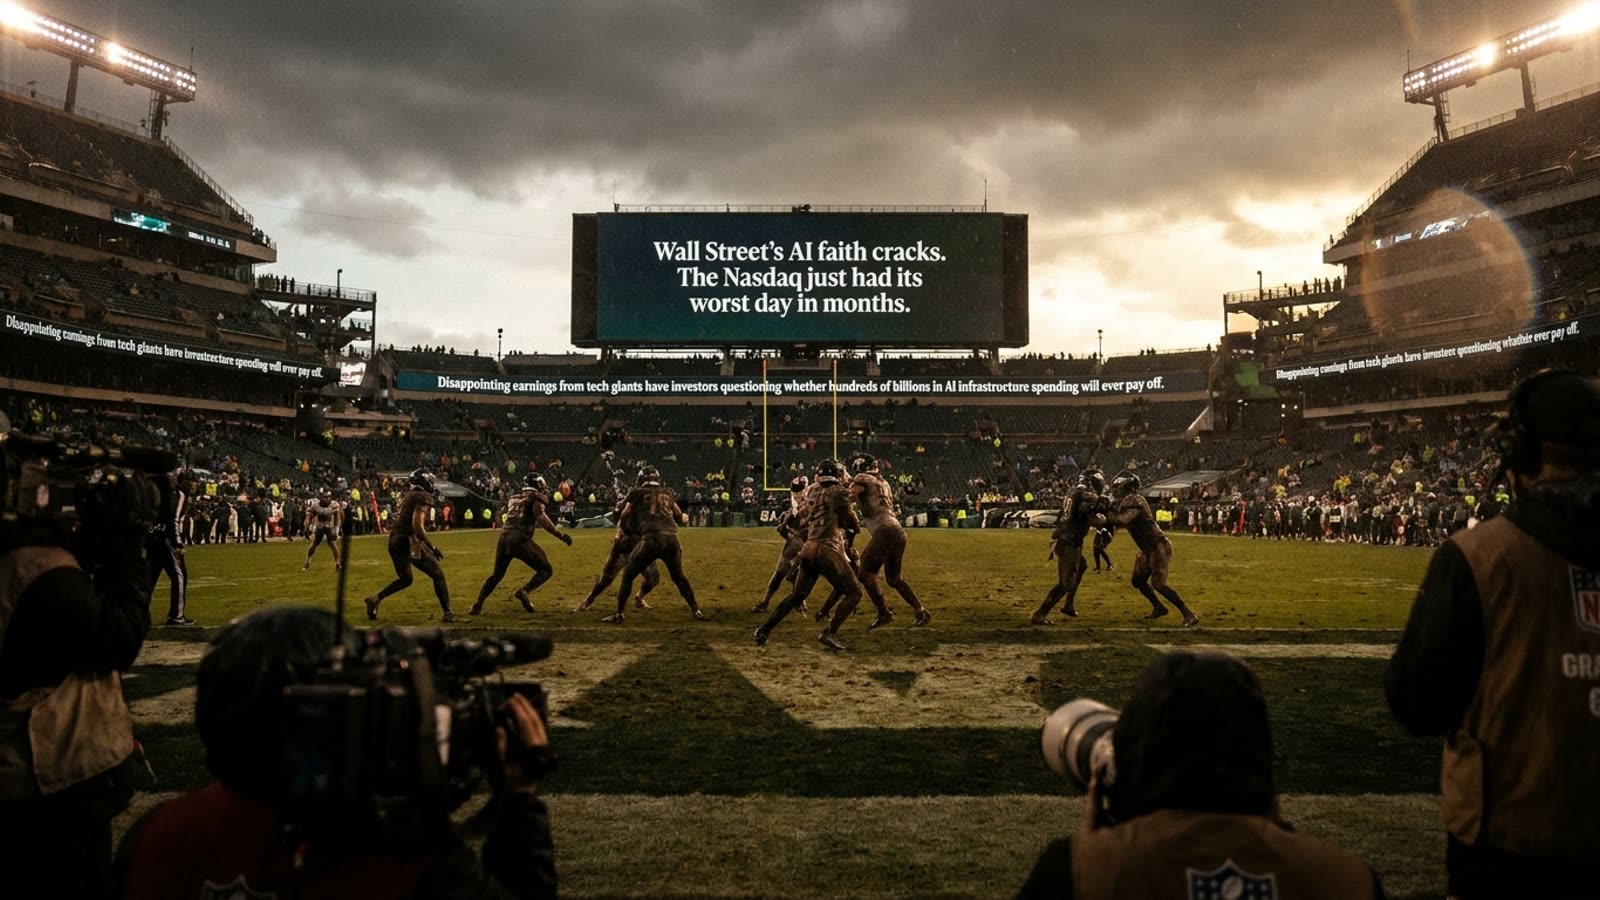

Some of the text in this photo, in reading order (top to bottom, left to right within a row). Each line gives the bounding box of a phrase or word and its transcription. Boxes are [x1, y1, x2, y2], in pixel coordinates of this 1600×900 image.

[654, 240, 946, 261] Wall Street’s AI faith cracks.
[677, 267, 922, 292] The Nasdaq just had its
[690, 293, 910, 317] worst day in months.
[438, 375, 510, 395] Disappointing
[513, 380, 557, 395] earnings
[560, 379, 584, 392] from
[587, 379, 609, 392] tech
[611, 380, 643, 396] giants
[645, 379, 669, 392] have
[672, 380, 718, 392] investors
[720, 380, 782, 395] questioning
[784, 379, 827, 392] whether
[829, 380, 878, 392] hundreds
[880, 379, 892, 393] of
[893, 379, 930, 393] billions
[933, 380, 942, 392] in
[1032, 379, 1079, 396] spending
[1081, 379, 1099, 392] will
[1102, 381, 1124, 392] ever
[1126, 380, 1145, 394] pay
[1147, 375, 1164, 390] off.
